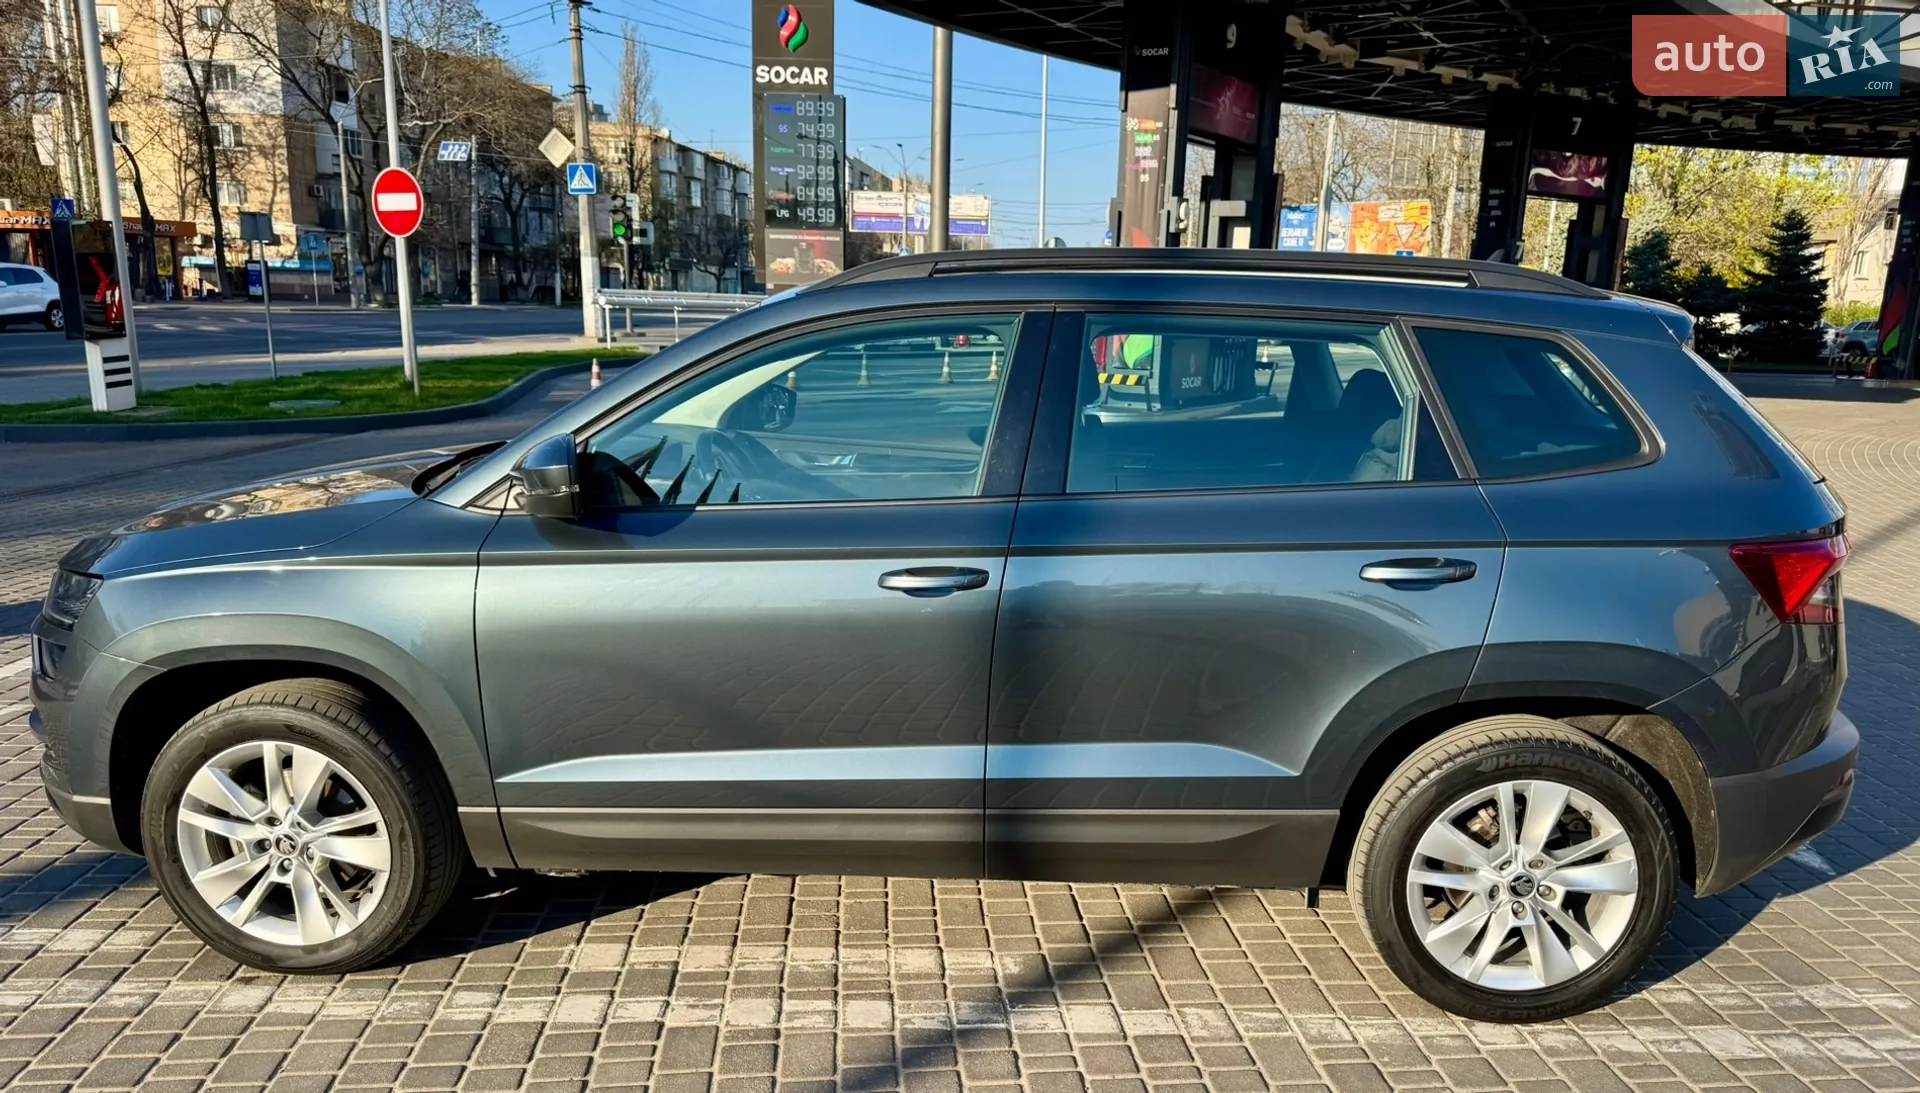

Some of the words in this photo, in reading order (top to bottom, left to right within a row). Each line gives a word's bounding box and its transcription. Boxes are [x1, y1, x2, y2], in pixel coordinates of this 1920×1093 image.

[1226, 23, 1237, 49] 9
[1141, 47, 1169, 57] SOCAR
[755, 65, 829, 86] SOCAR
[1571, 117, 1582, 136] 7
[776, 209, 790, 218] LPG
[1515, 241, 1525, 260] 7
[1181, 376, 1202, 389] SOCAR
